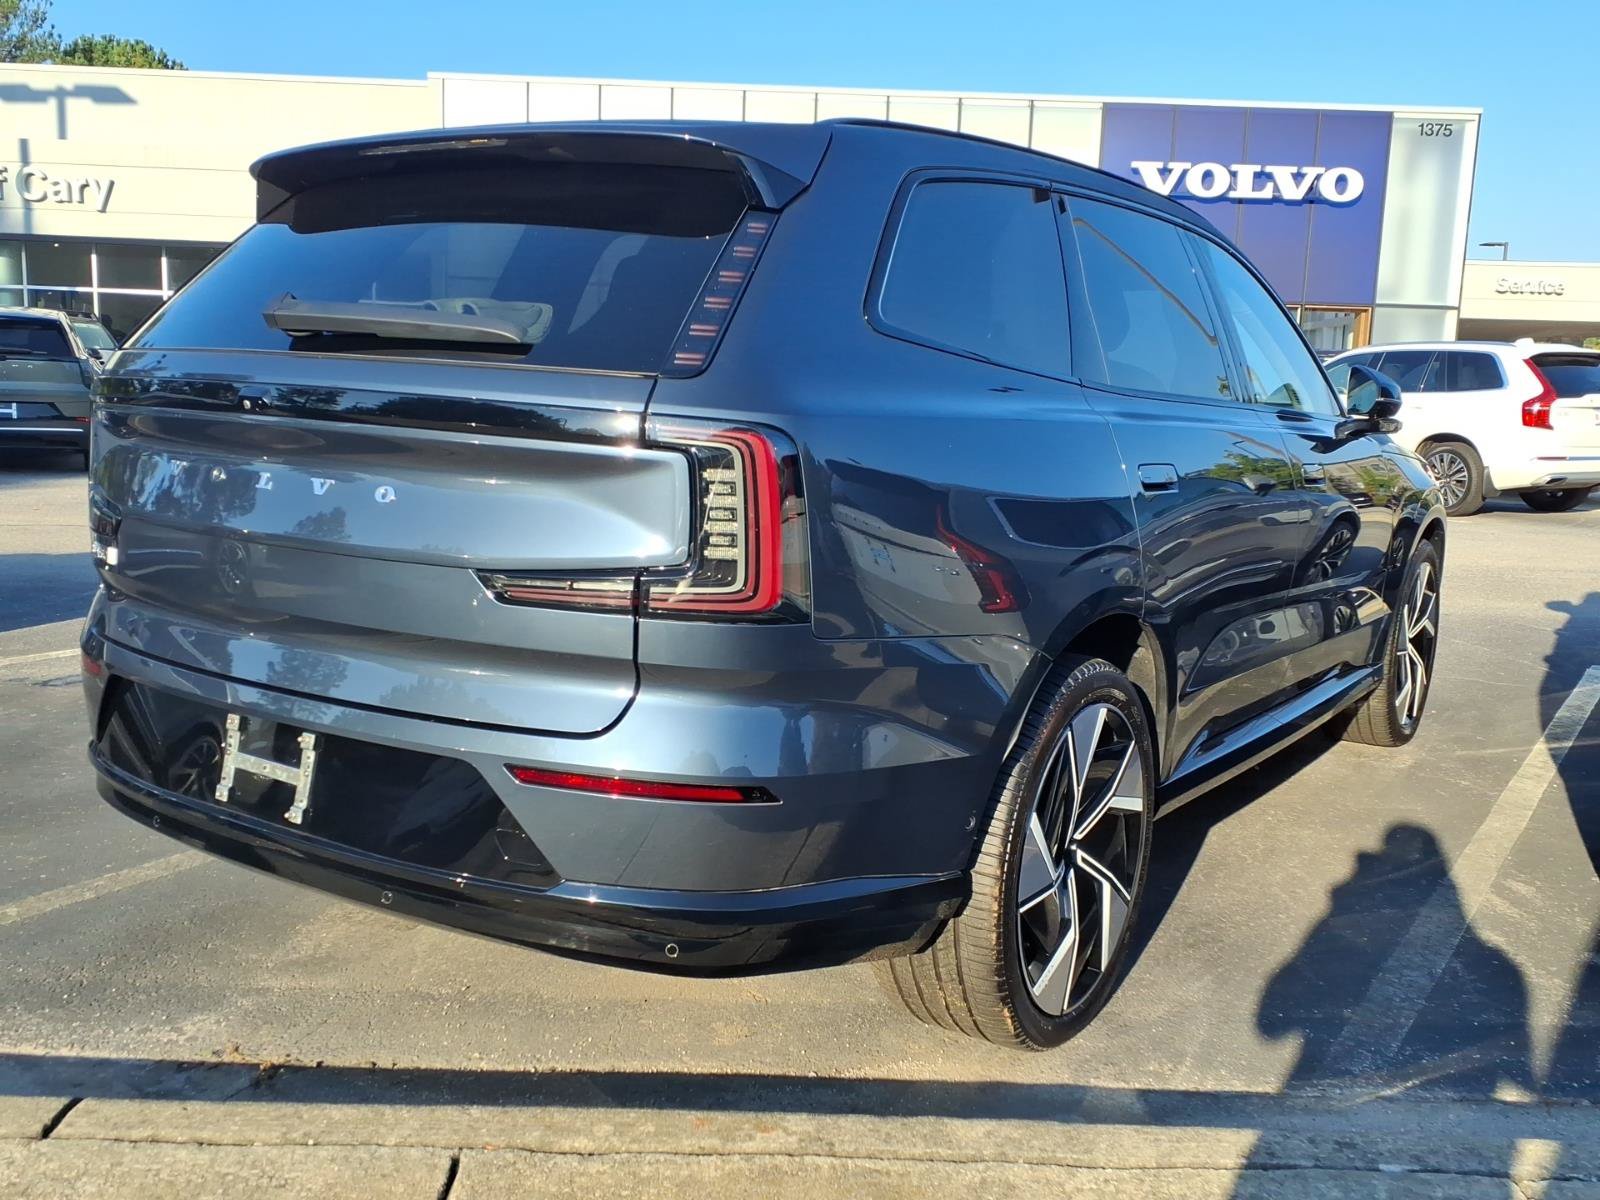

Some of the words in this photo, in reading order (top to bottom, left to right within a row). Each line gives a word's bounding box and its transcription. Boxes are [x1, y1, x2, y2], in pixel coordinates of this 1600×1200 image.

[1418, 122, 1453, 137] 1375
[15, 166, 115, 213] Cary
[1131, 161, 1364, 202] VOLVO
[1496, 277, 1565, 296] Service
[171, 459, 397, 503] VOLVO
